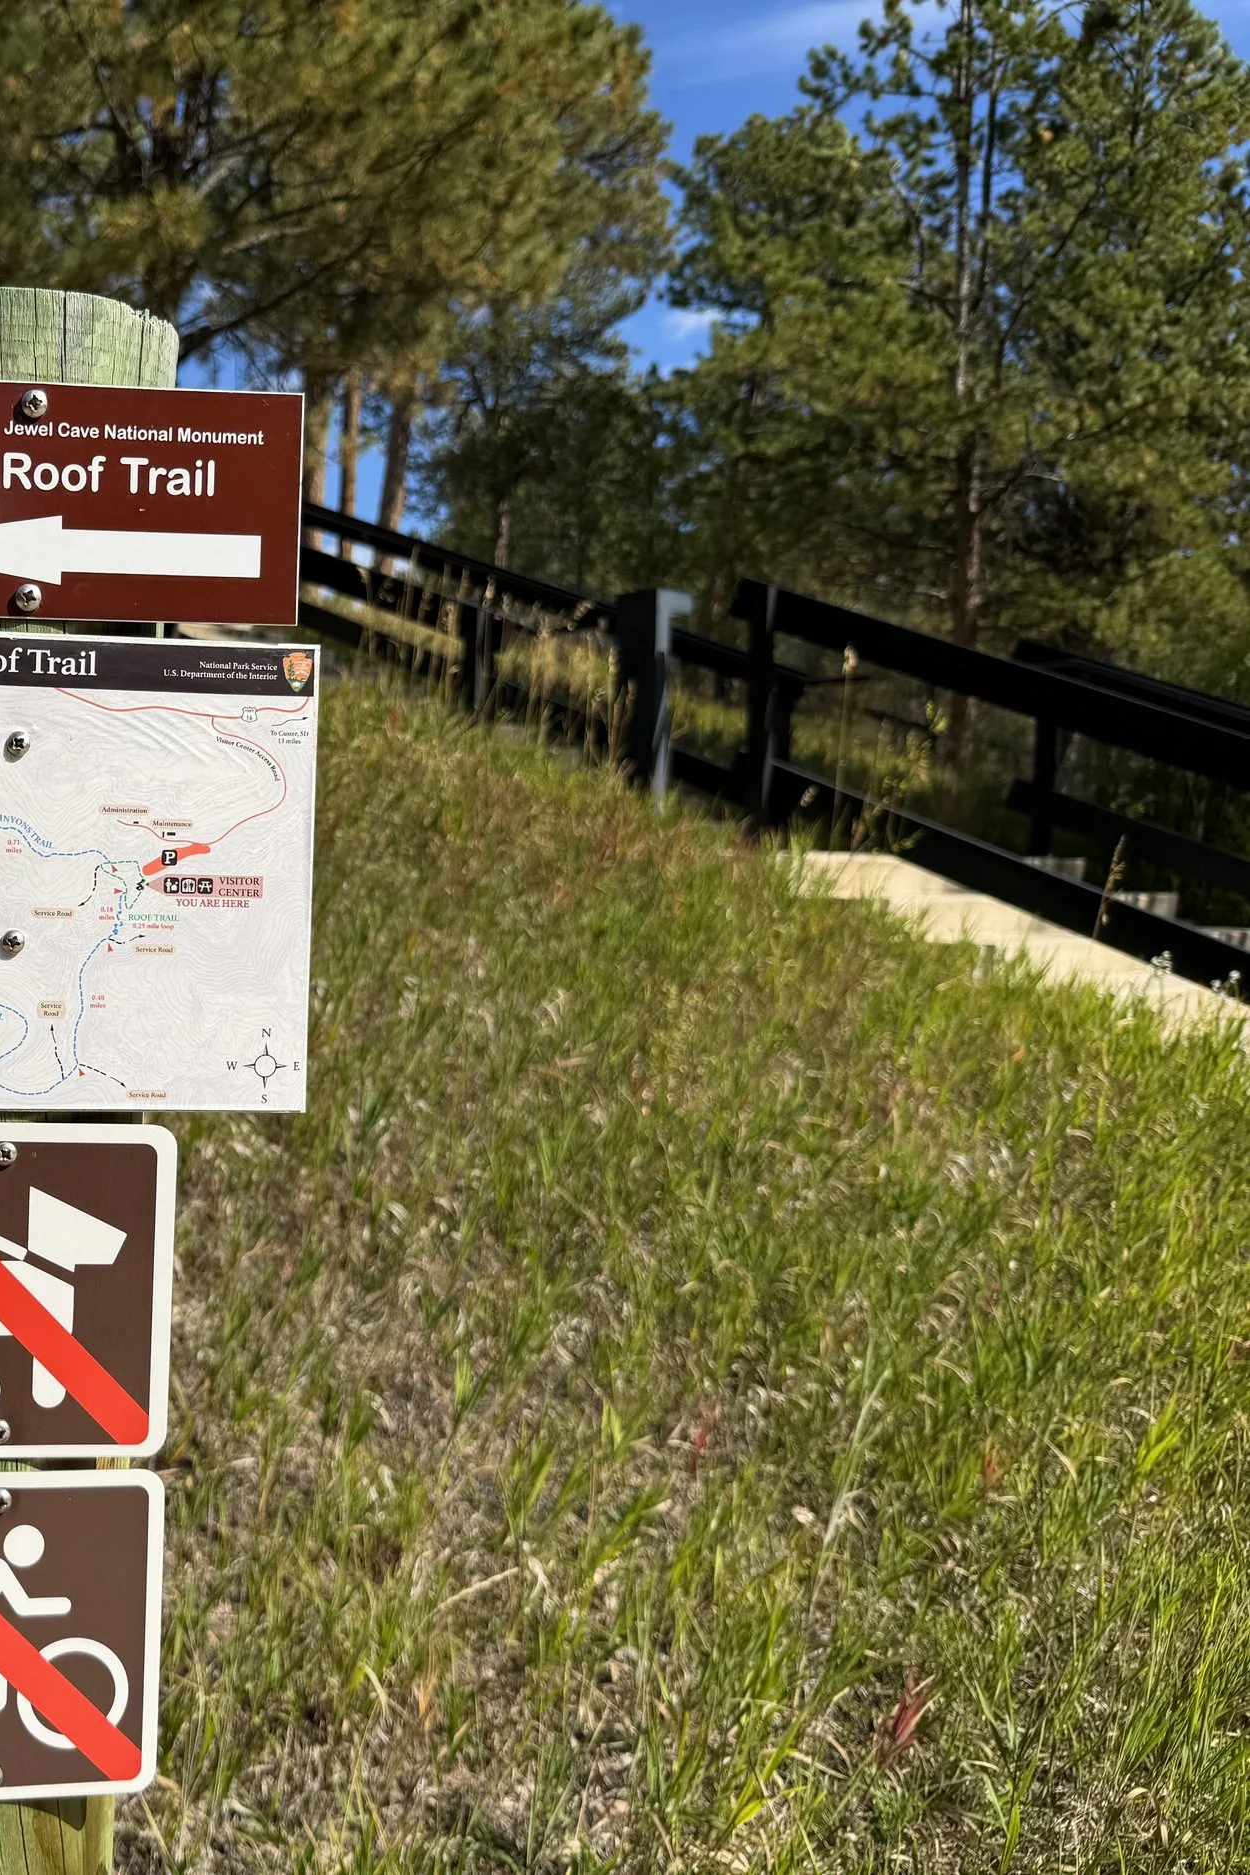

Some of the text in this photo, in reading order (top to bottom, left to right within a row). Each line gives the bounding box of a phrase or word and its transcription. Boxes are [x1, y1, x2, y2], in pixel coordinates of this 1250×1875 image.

[4, 420, 265, 445] Jewel Cave National Monument
[2, 452, 216, 498] Roof Trail
[27, 648, 98, 676] Trail
[199, 661, 278, 672] National Park Service
[163, 669, 278, 681] U.S. Department of the Interior
[216, 735, 235, 746] Visitor
[235, 741, 255, 754] Center
[101, 806, 148, 814] Administration
[152, 820, 192, 828] Maintenance
[30, 830, 54, 849] TRAIL
[219, 876, 260, 886] VISITOR
[218, 888, 260, 898] CENTER
[176, 898, 250, 909] YOU ARE HERE
[154, 914, 180, 922] TRAIL
[261, 1028, 272, 1038] N
[226, 1061, 238, 1070] W
[293, 1062, 300, 1071] E
[260, 1094, 268, 1104] S
